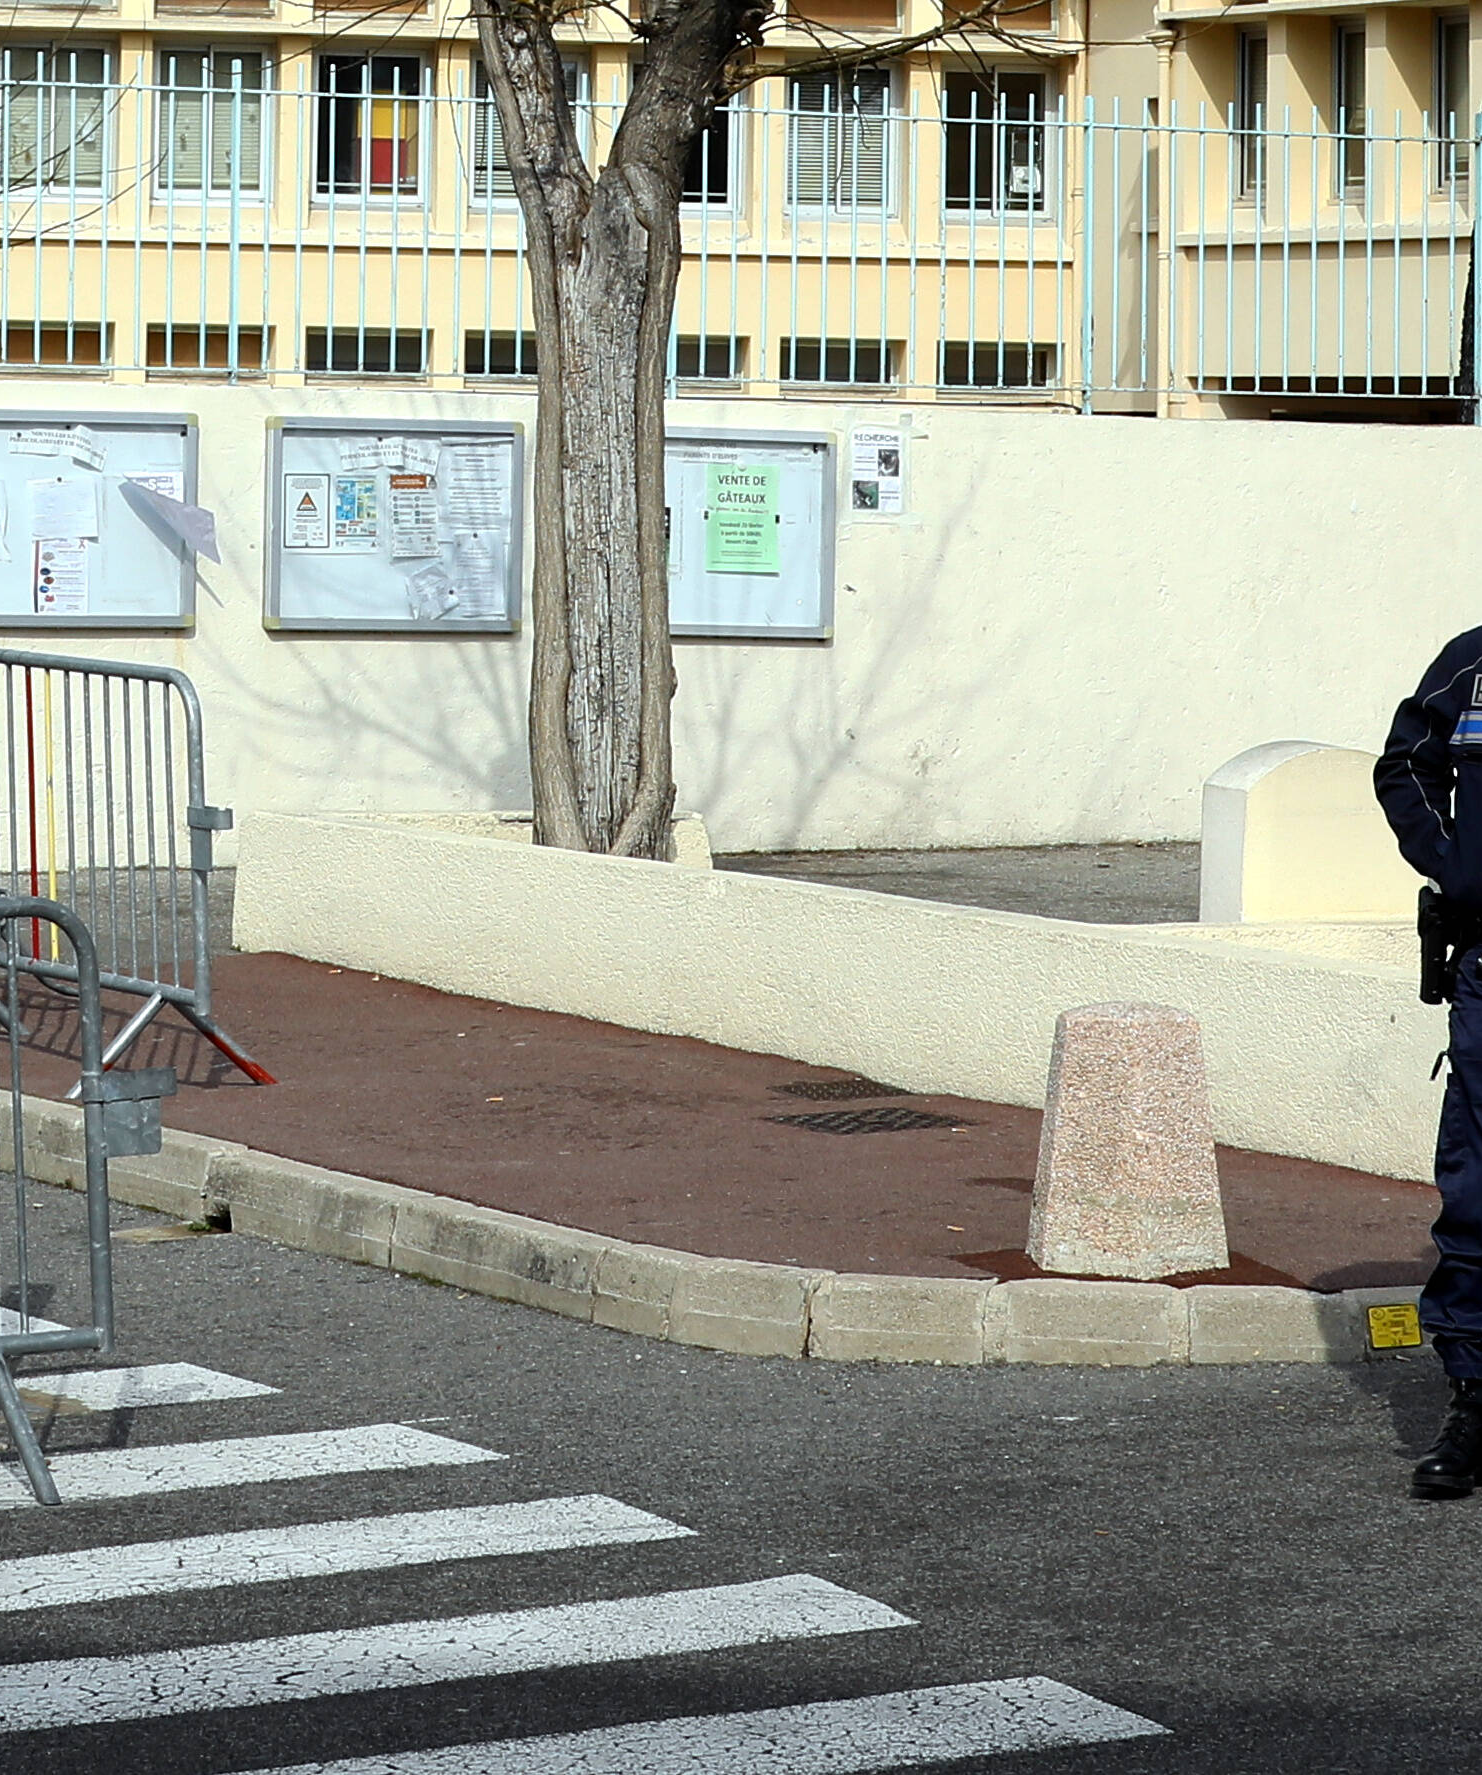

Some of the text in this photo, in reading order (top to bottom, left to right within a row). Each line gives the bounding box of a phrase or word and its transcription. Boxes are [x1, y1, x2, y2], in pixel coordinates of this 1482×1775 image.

[717, 474, 767, 487] VENTE DE
[717, 490, 767, 505] GÂTEAUX
